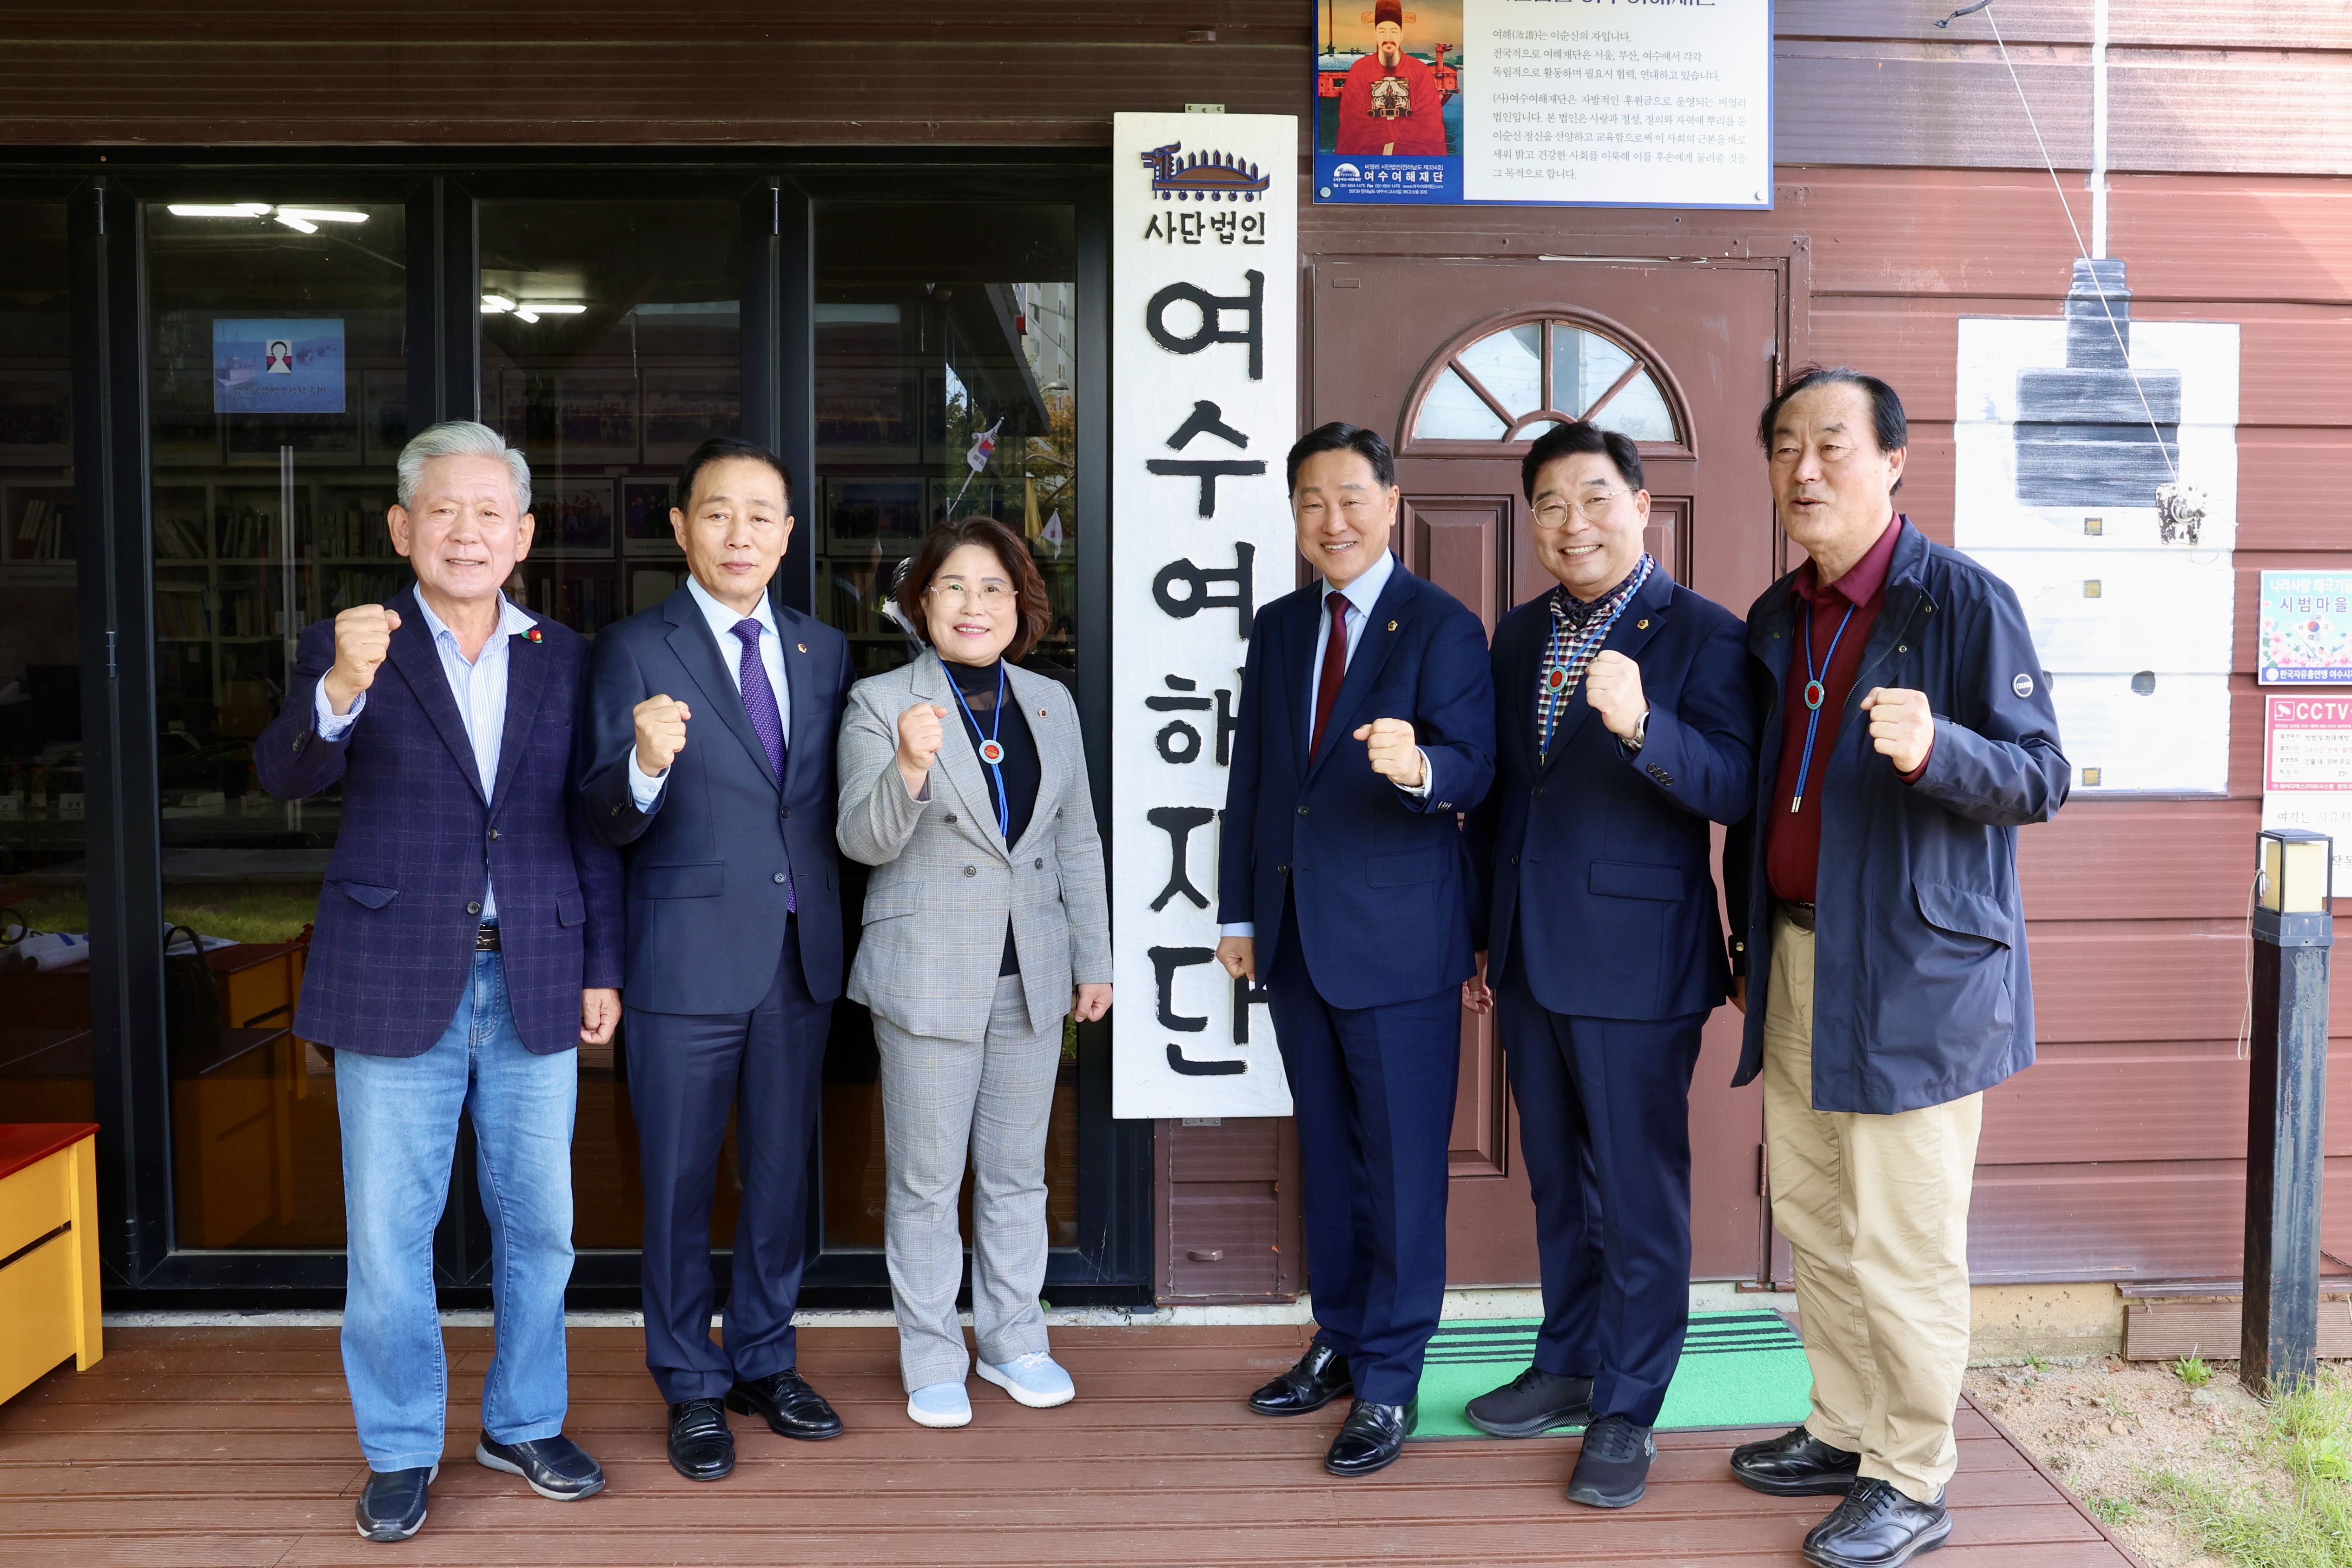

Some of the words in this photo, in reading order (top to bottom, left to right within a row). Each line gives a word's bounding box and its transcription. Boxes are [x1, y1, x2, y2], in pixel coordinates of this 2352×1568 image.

[1551, 30, 1588, 41] 이순신의
[1591, 31, 1631, 42] 자입니다.
[1493, 47, 1541, 59] 전국적으로
[1544, 48, 1592, 60] 여해재단은
[1594, 50, 1615, 61] 서울,
[1618, 50, 1639, 61] 부산,
[1643, 51, 1680, 62] 여수에서
[1683, 52, 1702, 62] 각각
[1492, 66, 1541, 78] 독립적으로
[1543, 67, 1581, 79] 활동하며
[1616, 69, 1636, 80] 협력,
[1641, 70, 1678, 80] 연대하고
[1681, 71, 1720, 81] 있습니다.
[1493, 93, 1577, 104] (사)여수여해재단은
[1581, 94, 1619, 106] 자발적인
[1624, 95, 1672, 106] 후원금으로
[1676, 96, 1714, 107] 운영되는
[1719, 97, 1746, 108] 비영리
[1493, 112, 1542, 123] 법인입니다.
[1546, 112, 1556, 123] 본
[1559, 112, 1587, 123] 법인은
[1589, 113, 1619, 124] 사랑과
[1621, 114, 1641, 125] 정성,
[1645, 114, 1673, 125] 정의와
[1676, 115, 1704, 126] 자력에
[1707, 116, 1735, 126] 뿌리를
[1737, 116, 1747, 126] 둔
[1493, 130, 1521, 141] 이순신
[1524, 131, 1552, 142] 정신을
[1555, 131, 1593, 142] 선양하고
[1595, 132, 1652, 144] 교육함으로써
[1655, 133, 1663, 144] 이
[1666, 133, 1694, 144] 사회의
[1697, 134, 1725, 145] 근본을
[1728, 134, 1747, 145] 바로
[1493, 149, 1511, 160] 세워
[1515, 149, 1534, 160] 밝고
[1538, 150, 1566, 160] 건강한
[1569, 150, 1599, 161] 사회를
[1602, 151, 1629, 162] 이룩해
[1634, 151, 1652, 162] 이를
[1655, 152, 1692, 163] 후손에게
[1697, 153, 1725, 163] 물려줄
[1728, 153, 1747, 164] 것을
[1364, 171, 1443, 182] 여수여해재단
[1505, 168, 1544, 179] 목적으로
[1546, 168, 1577, 179] 합니다.
[1144, 211, 1265, 245] 사단법인
[2270, 578, 2311, 594] 나라사랑
[2280, 596, 2348, 613] 시범마을
[2279, 669, 2328, 679] 한국자유총연맹
[2296, 702, 2349, 720] CCTV
[2278, 812, 2310, 823] 여기는
